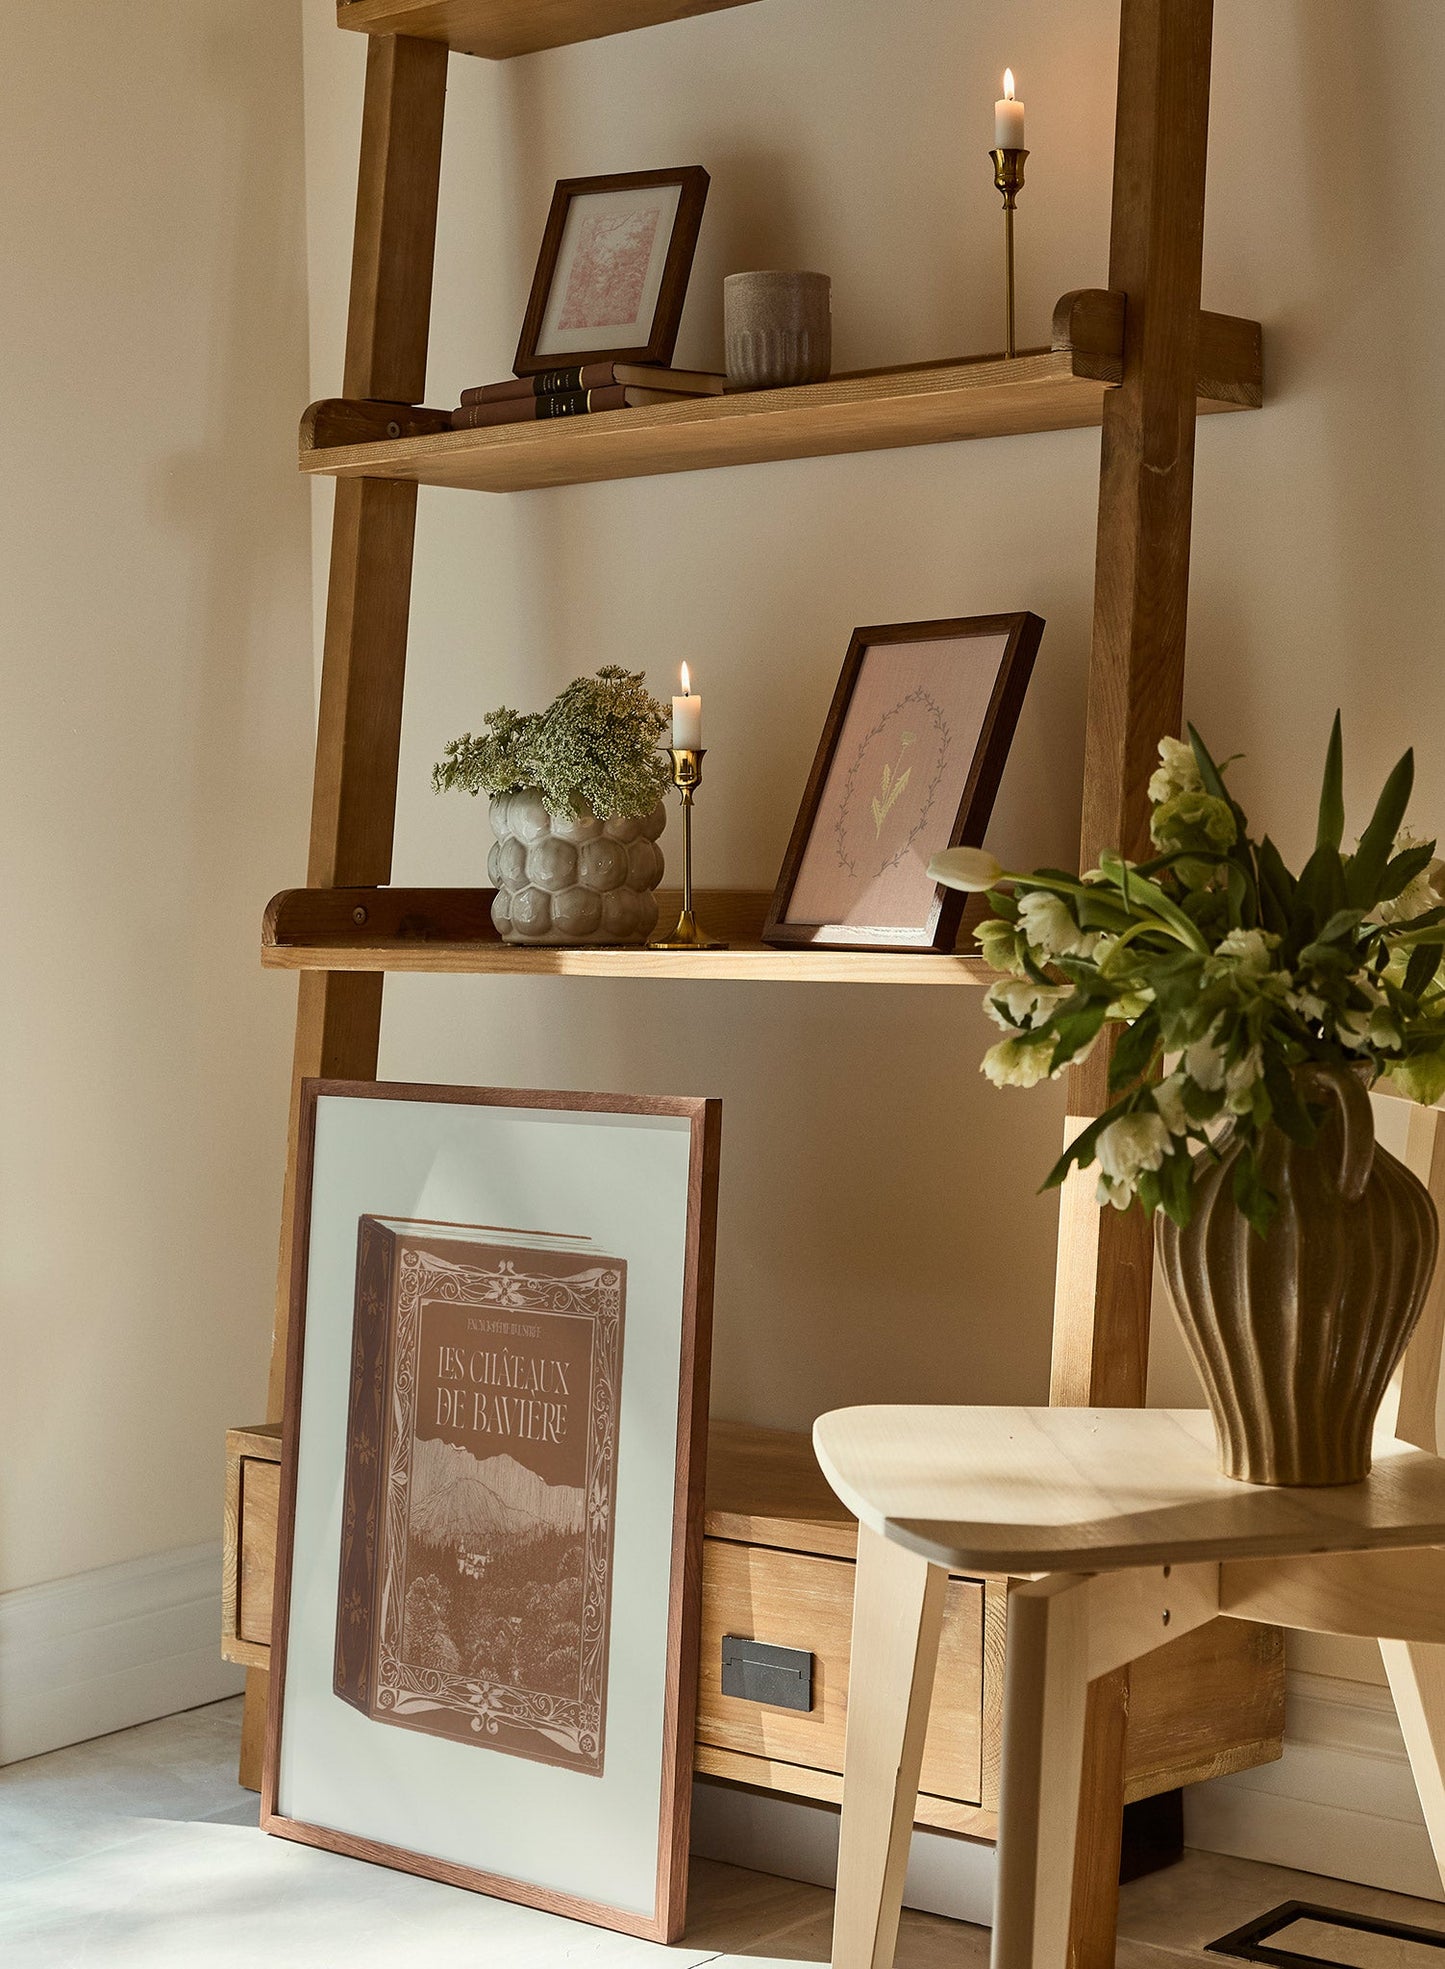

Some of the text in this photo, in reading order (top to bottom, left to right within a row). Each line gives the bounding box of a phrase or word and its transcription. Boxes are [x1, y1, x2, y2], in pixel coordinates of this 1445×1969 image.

[438, 1345, 571, 1395] LES CHÂTEAUX
[436, 1387, 569, 1444] DE BAVIÈRE
